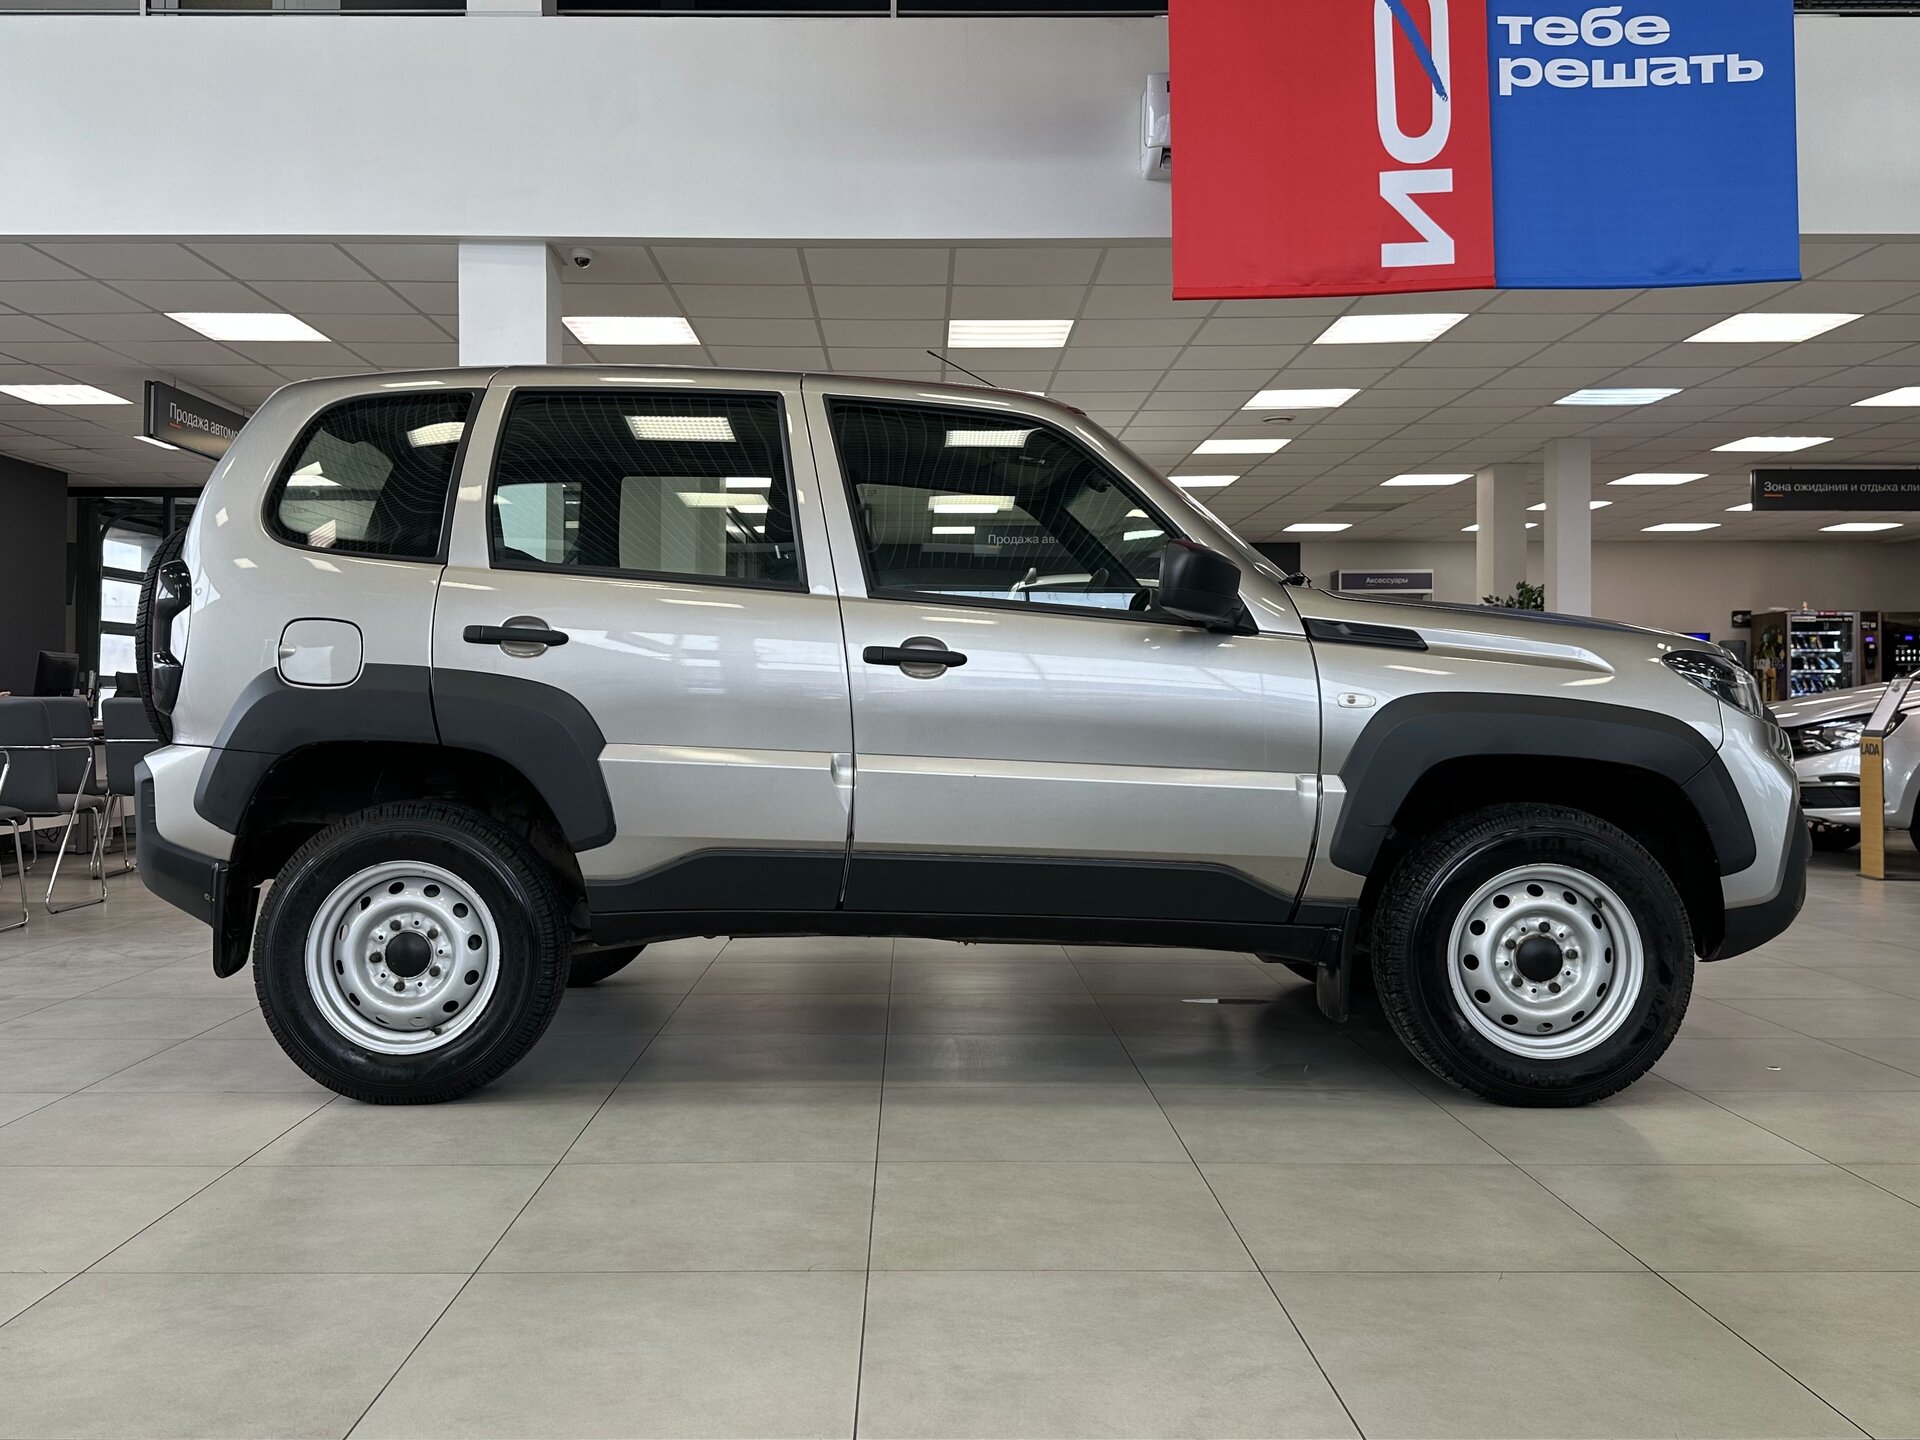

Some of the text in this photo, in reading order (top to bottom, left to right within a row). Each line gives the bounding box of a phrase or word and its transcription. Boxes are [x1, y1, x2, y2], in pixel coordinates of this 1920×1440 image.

[1498, 6, 1671, 47] тебе
[1498, 53, 1764, 96] решать
[169, 402, 209, 431] Продажа
[1763, 481, 1792, 492] Зона
[1793, 483, 1849, 493] ожидания
[1850, 483, 1857, 492] и
[1859, 483, 1899, 493] отдыха
[988, 534, 1039, 546] Продажа
[1860, 742, 1880, 756] LADA
